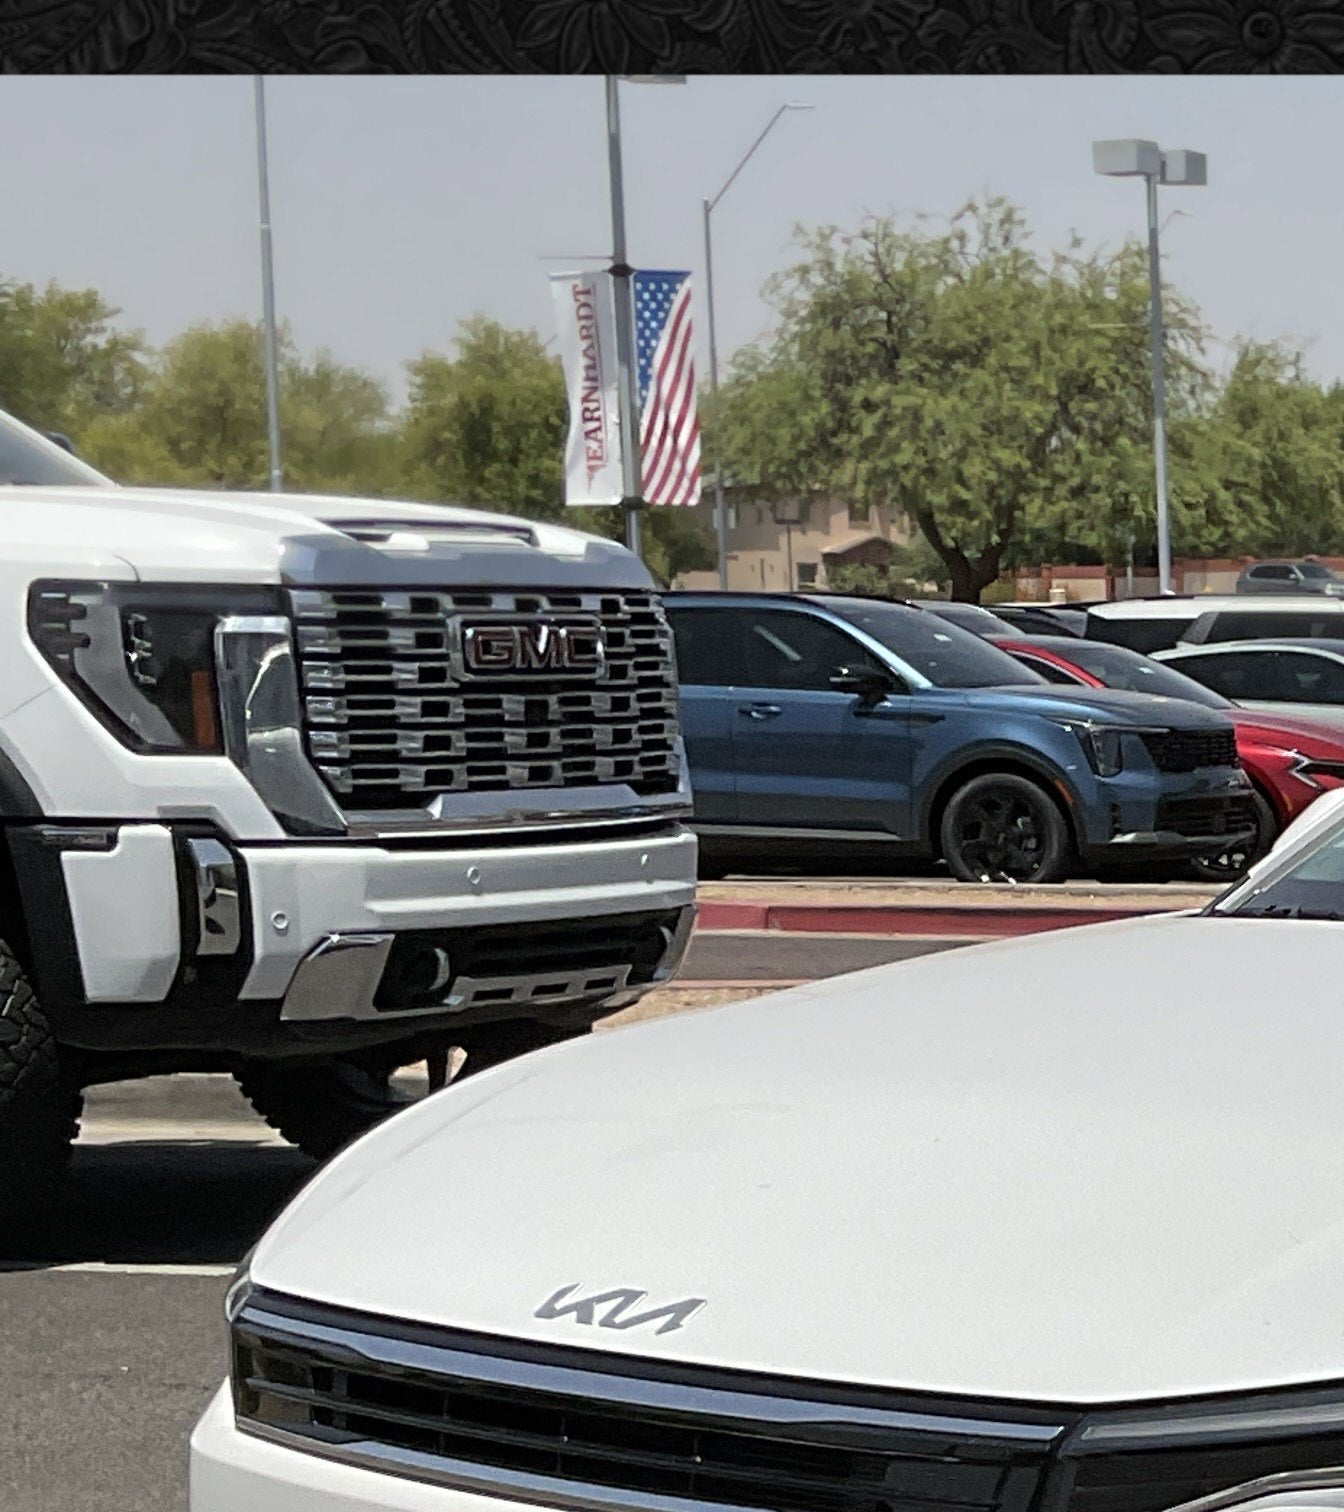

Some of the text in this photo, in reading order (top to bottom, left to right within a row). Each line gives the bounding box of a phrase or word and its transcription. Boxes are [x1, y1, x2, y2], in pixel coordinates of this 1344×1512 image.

[572, 283, 604, 465] EARNHARDT
[466, 626, 603, 668] GMC
[534, 1283, 708, 1336] KIA
